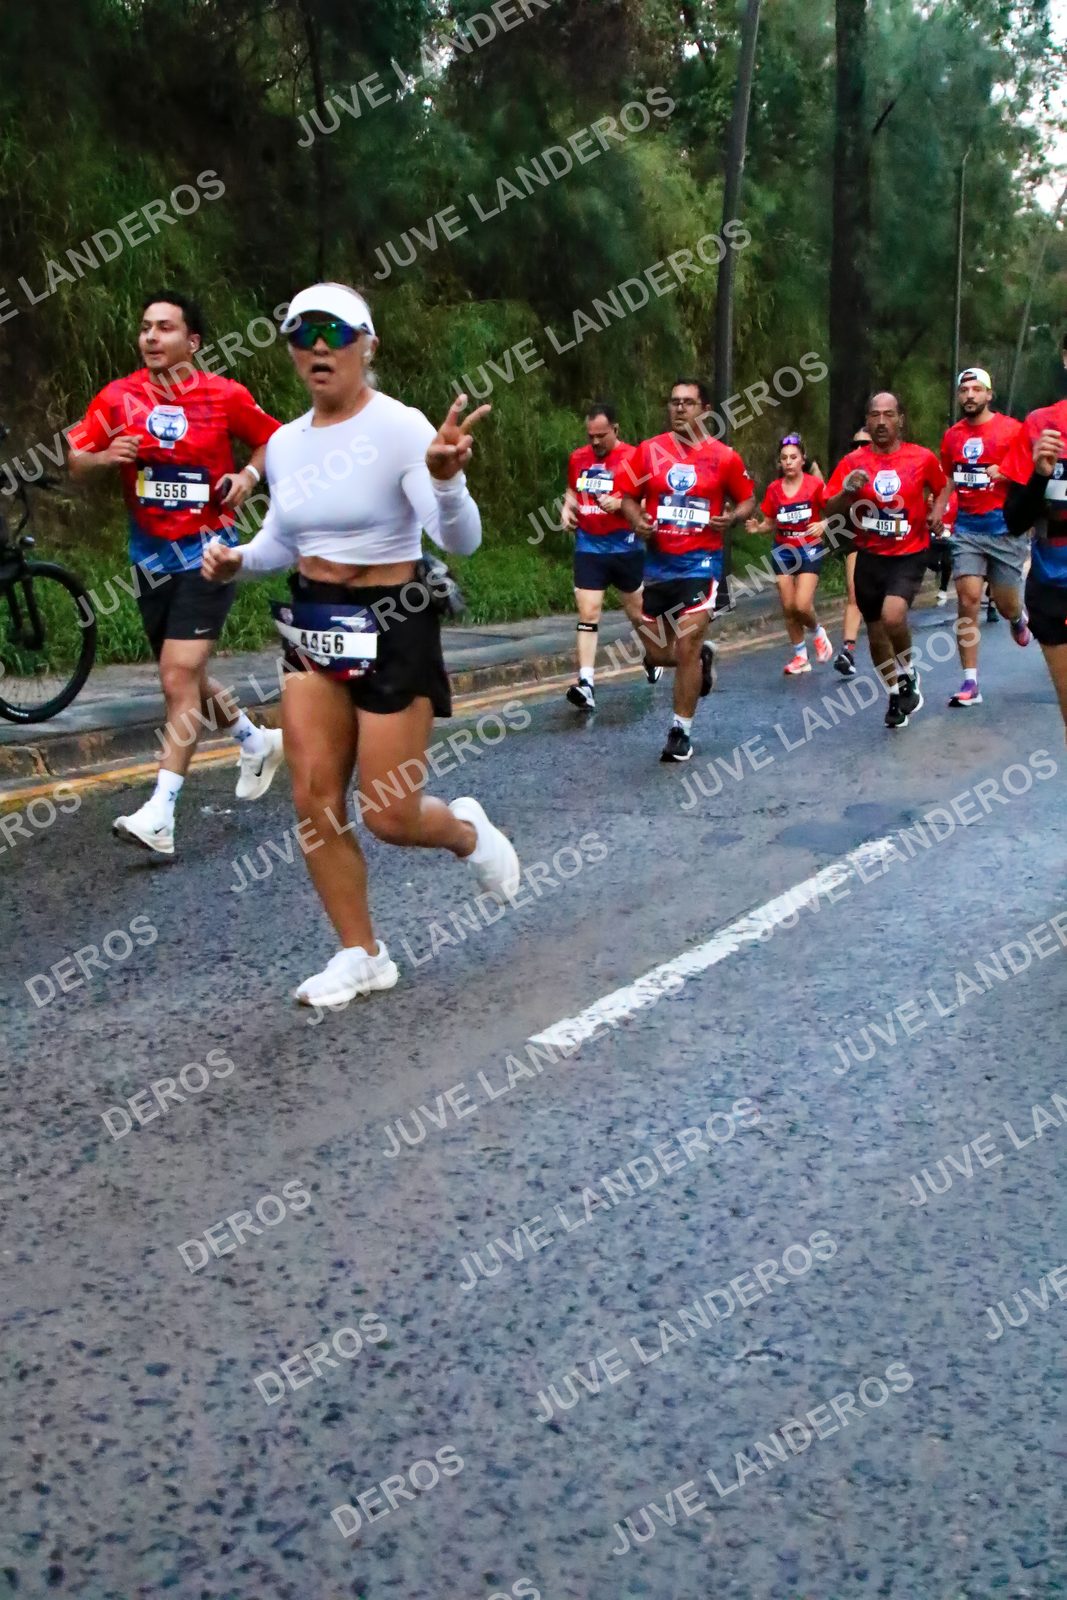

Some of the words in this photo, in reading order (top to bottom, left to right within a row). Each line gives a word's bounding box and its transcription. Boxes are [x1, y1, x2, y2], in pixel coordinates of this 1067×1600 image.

[155, 483, 187, 498] 5558
[672, 508, 695, 520] 4470
[876, 521, 893, 531] 4151
[300, 631, 344, 655] 4456
